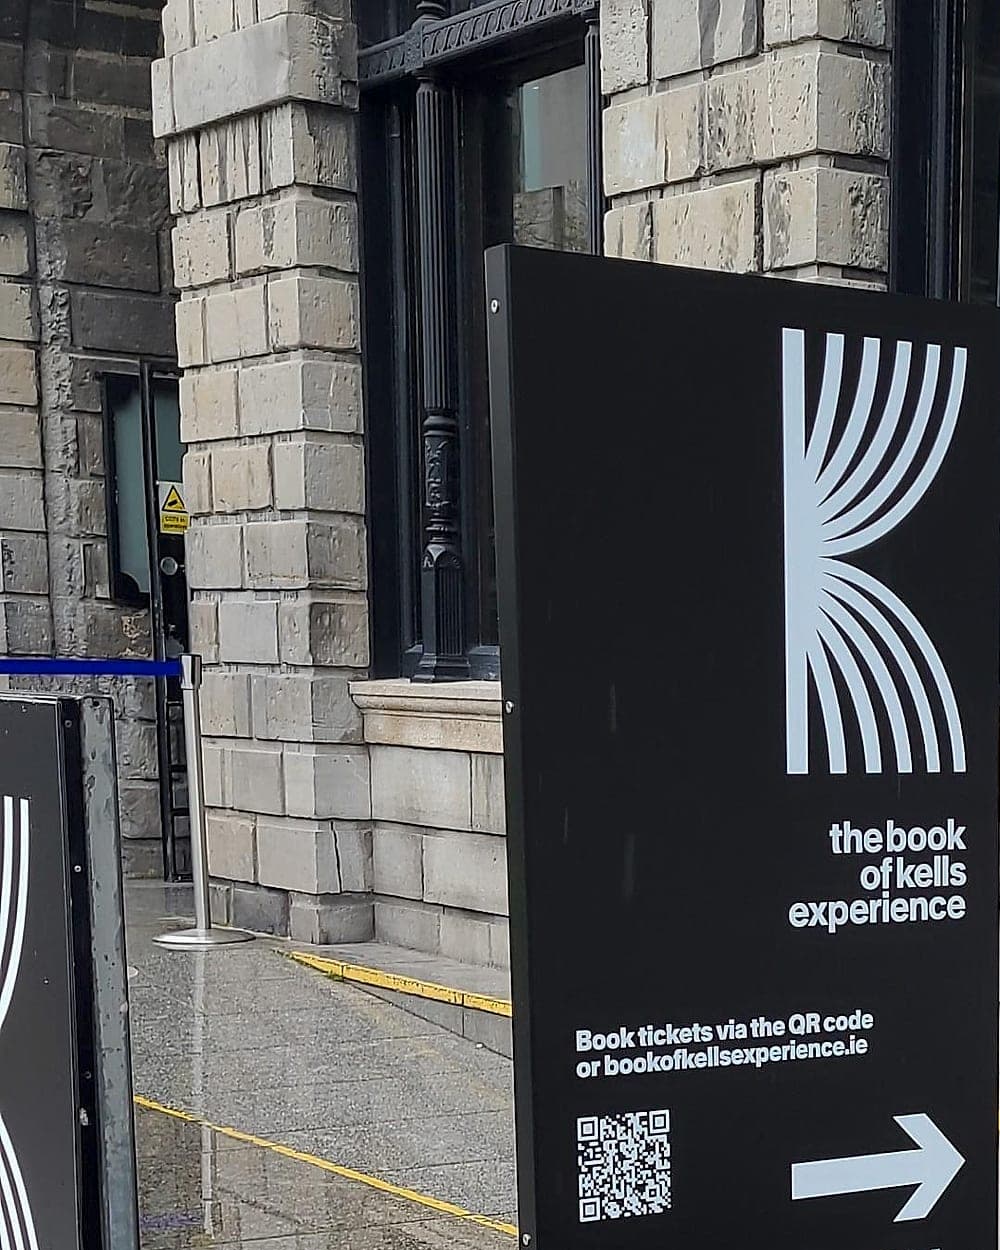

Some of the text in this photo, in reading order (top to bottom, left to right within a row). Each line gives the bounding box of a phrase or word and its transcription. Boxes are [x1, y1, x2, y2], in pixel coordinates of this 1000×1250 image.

[829, 819, 967, 854] the book
[860, 855, 967, 890] of kells
[788, 891, 967, 934] experience
[576, 1010, 874, 1051] Book tickets via the QR code
[576, 1035, 868, 1079] or bookofkellsexperience.ie
